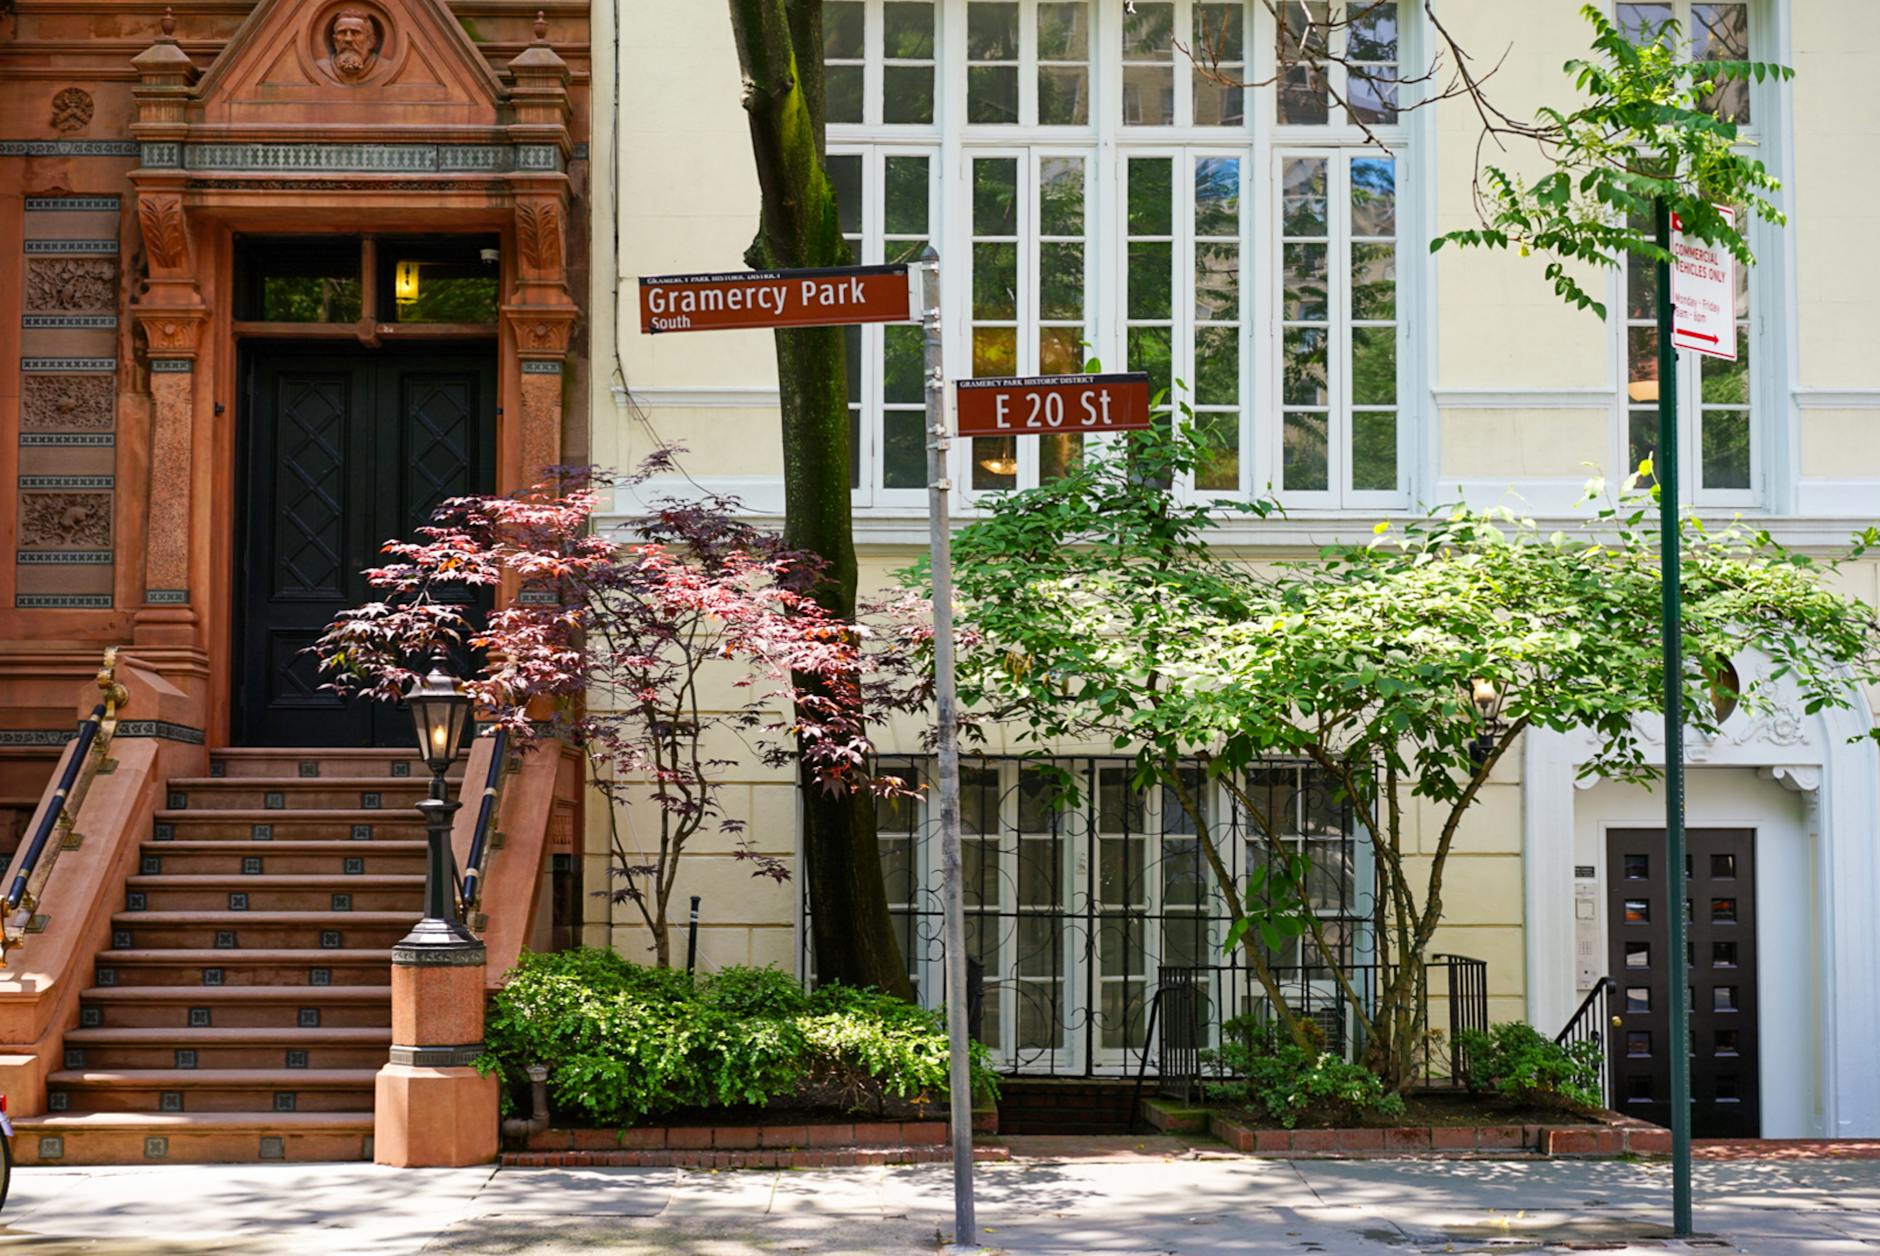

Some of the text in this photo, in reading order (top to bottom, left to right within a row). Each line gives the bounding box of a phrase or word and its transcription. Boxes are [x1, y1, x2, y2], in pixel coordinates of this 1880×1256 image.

[1675, 243, 1718, 266] COMMERCIAL
[1709, 267, 1726, 283] ONLY
[648, 277, 866, 315] Gramercy Park
[651, 315, 690, 329] South
[960, 380, 1001, 388] GRAMERCY
[1024, 377, 1058, 385] HISTORIC
[1060, 376, 1094, 384] DISTRICT
[996, 389, 1112, 429] E 20 St
